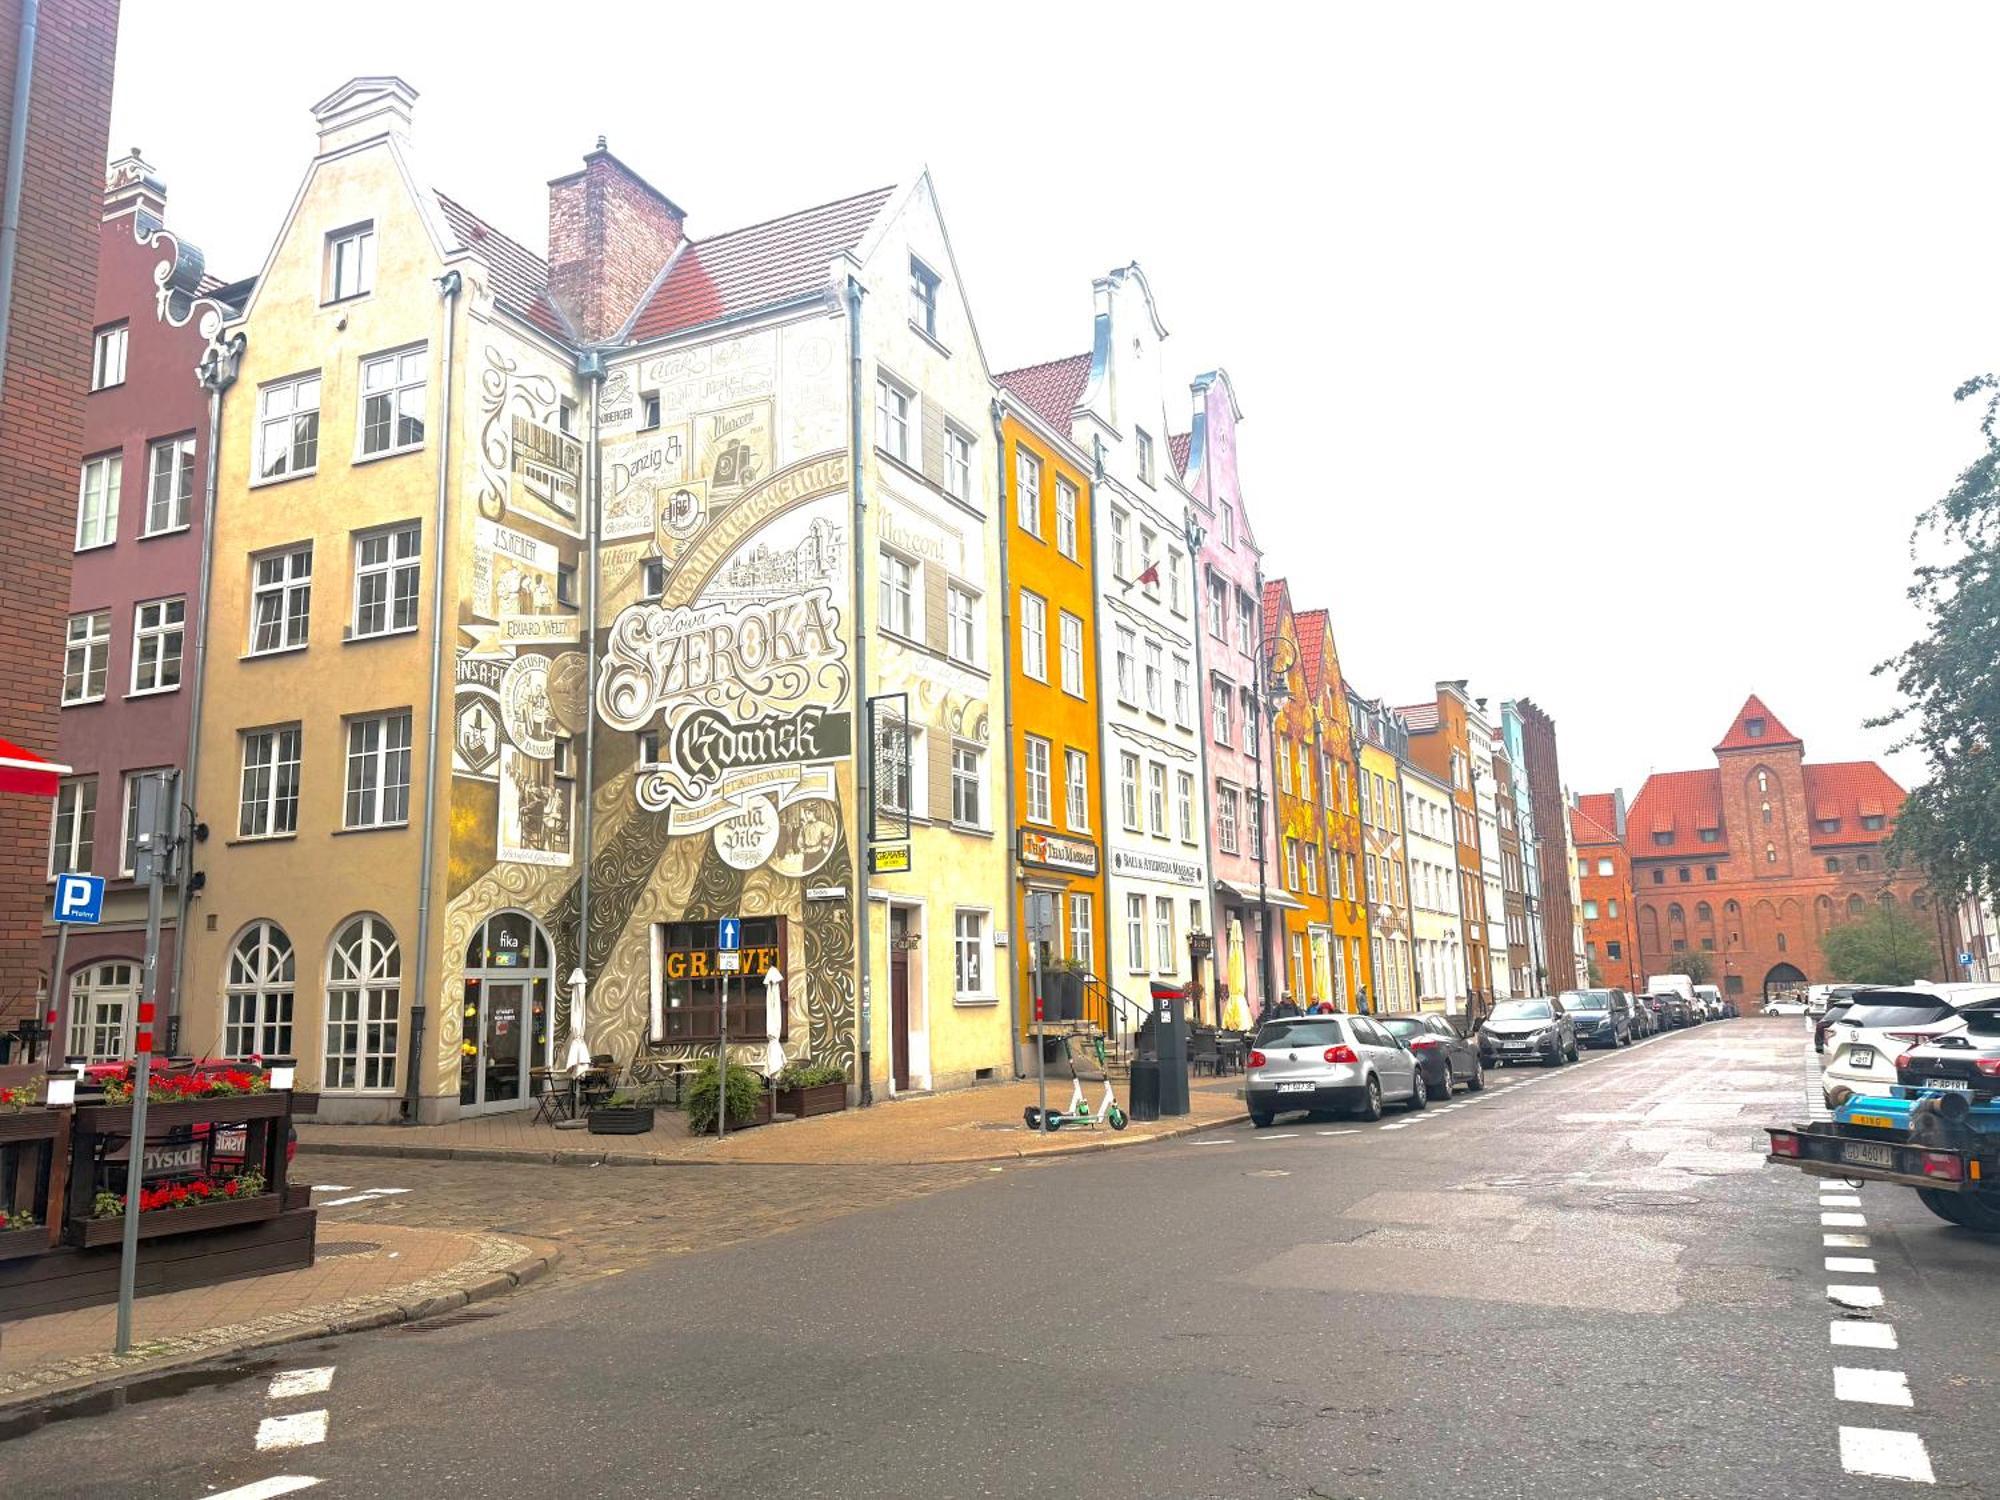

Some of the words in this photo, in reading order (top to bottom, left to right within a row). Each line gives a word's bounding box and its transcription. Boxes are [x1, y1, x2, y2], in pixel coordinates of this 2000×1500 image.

[611, 449, 662, 496] Danzig
[608, 598, 834, 719] SZEROKA
[682, 708, 822, 777] Gdańsk
[62, 879, 92, 915] P
[500, 930, 519, 948] fika
[1162, 999, 1169, 1009] P
[144, 1148, 201, 1170] TYSKIE
